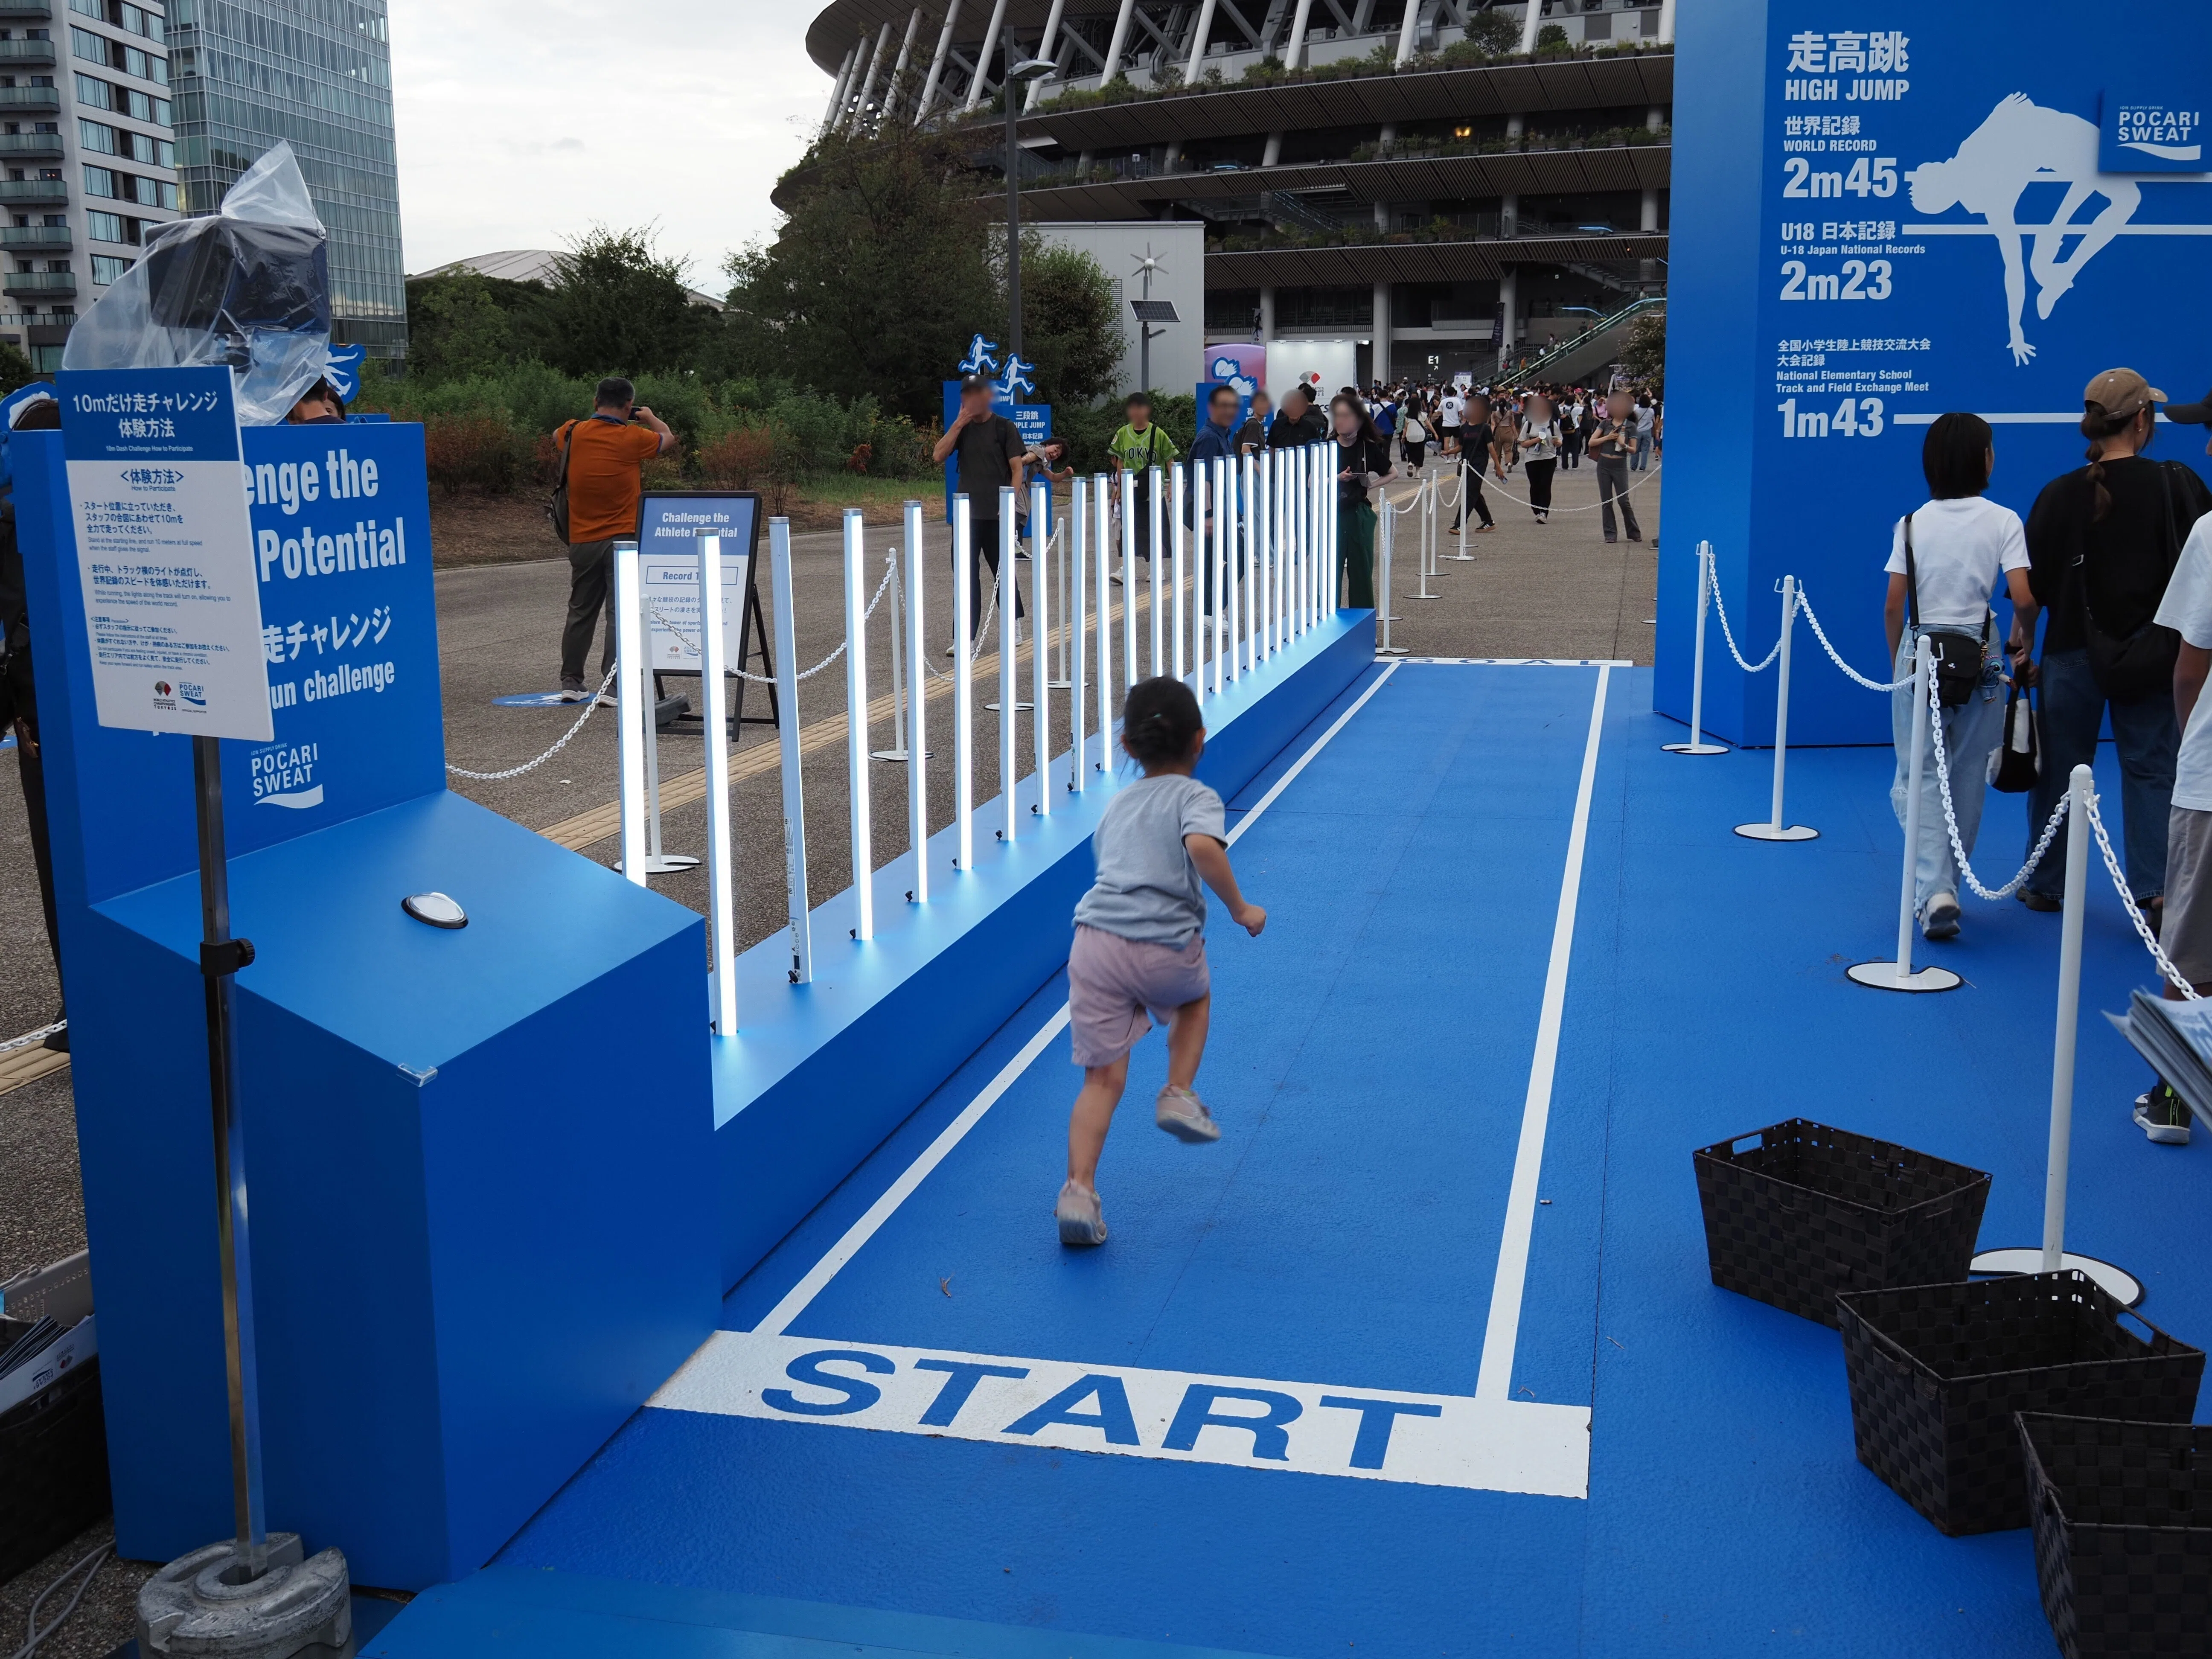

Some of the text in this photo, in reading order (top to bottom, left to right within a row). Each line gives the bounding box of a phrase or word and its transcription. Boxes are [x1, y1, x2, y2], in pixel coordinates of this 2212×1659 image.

[1786, 31, 1910, 73] 走高跳
[1785, 79, 1909, 100] HIGH JUMP
[1784, 116, 1860, 136] 世界記録
[2119, 112, 2199, 125] POCARI
[2118, 127, 2192, 141] SWEAT
[1784, 140, 1877, 151] WORLD RECORD
[1783, 157, 1897, 198] 2m45
[1781, 221, 1895, 240] U18 日本記録
[1781, 244, 1925, 256] U-18 Japan National Records
[1780, 260, 1892, 300] 2m23
[1778, 338, 1931, 352] 全国小学生陸上競技交流大会
[1428, 356, 1439, 364] E1
[1777, 354, 1825, 367] 大会記録
[1777, 370, 1912, 381] National Elementary School
[1776, 382, 1929, 393] Track and Field Exchange Meet
[73, 391, 218, 413] 10mだけ走チャレンジ
[1016, 410, 1039, 420] 三段跳
[1778, 397, 1883, 437] 1m43
[118, 417, 175, 438] 体験方法
[326, 449, 378, 499] the
[662, 512, 729, 524] Challenge the
[655, 527, 690, 537] Athlete
[258, 517, 406, 582] Potential
[663, 571, 692, 580] Record
[179, 684, 204, 692] POCARI
[269, 661, 395, 710] un challenge
[260, 746, 274, 754] SUPPLY
[251, 743, 318, 777] POCARI
[253, 764, 313, 797] SWEAT
[761, 1348, 1442, 1470] START
